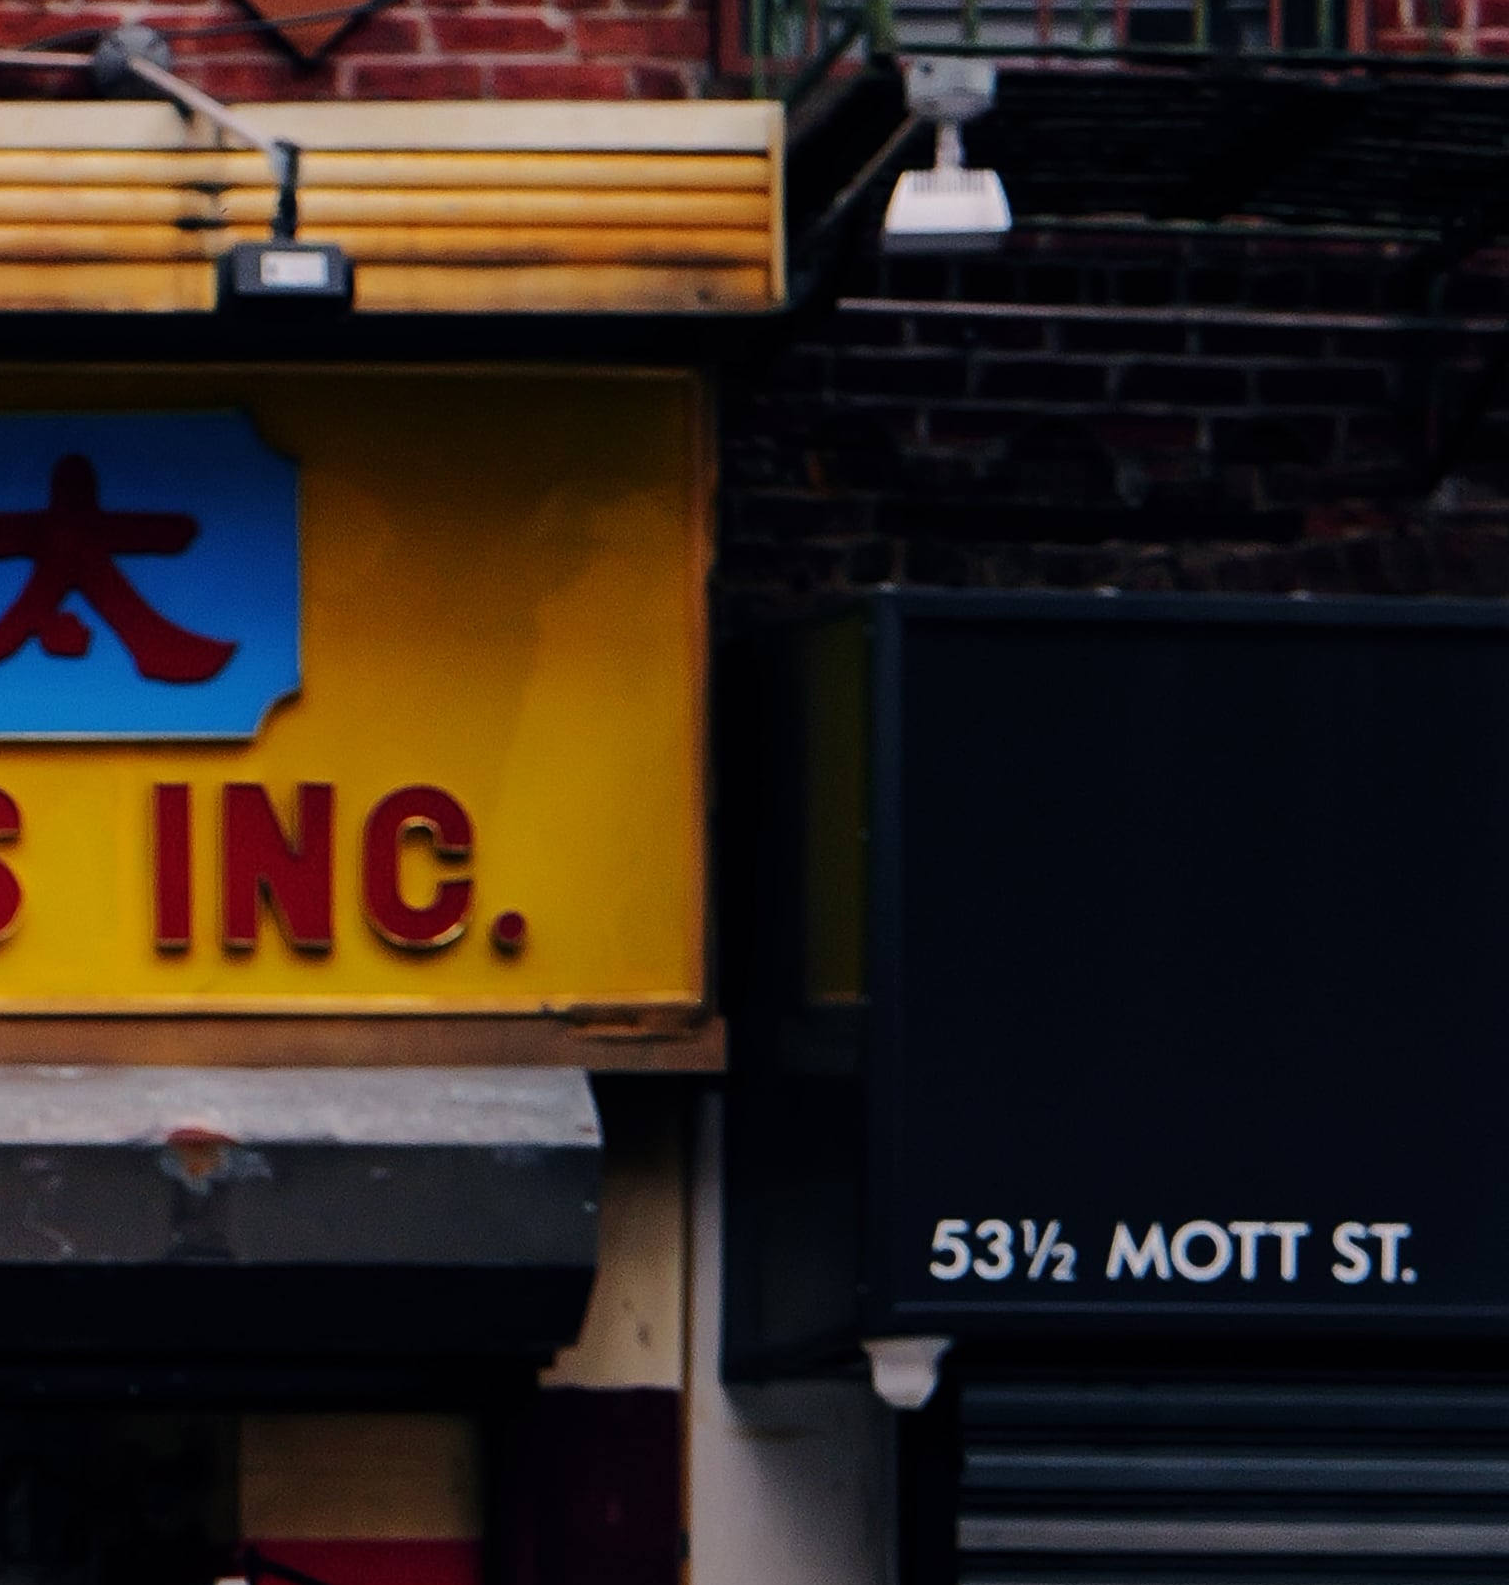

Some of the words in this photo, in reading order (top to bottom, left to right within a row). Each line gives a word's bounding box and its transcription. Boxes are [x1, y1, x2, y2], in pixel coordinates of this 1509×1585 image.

[153, 779, 531, 957] INC.
[1105, 1219, 1310, 1283] MOTT
[1330, 1221, 1418, 1283] ST.
